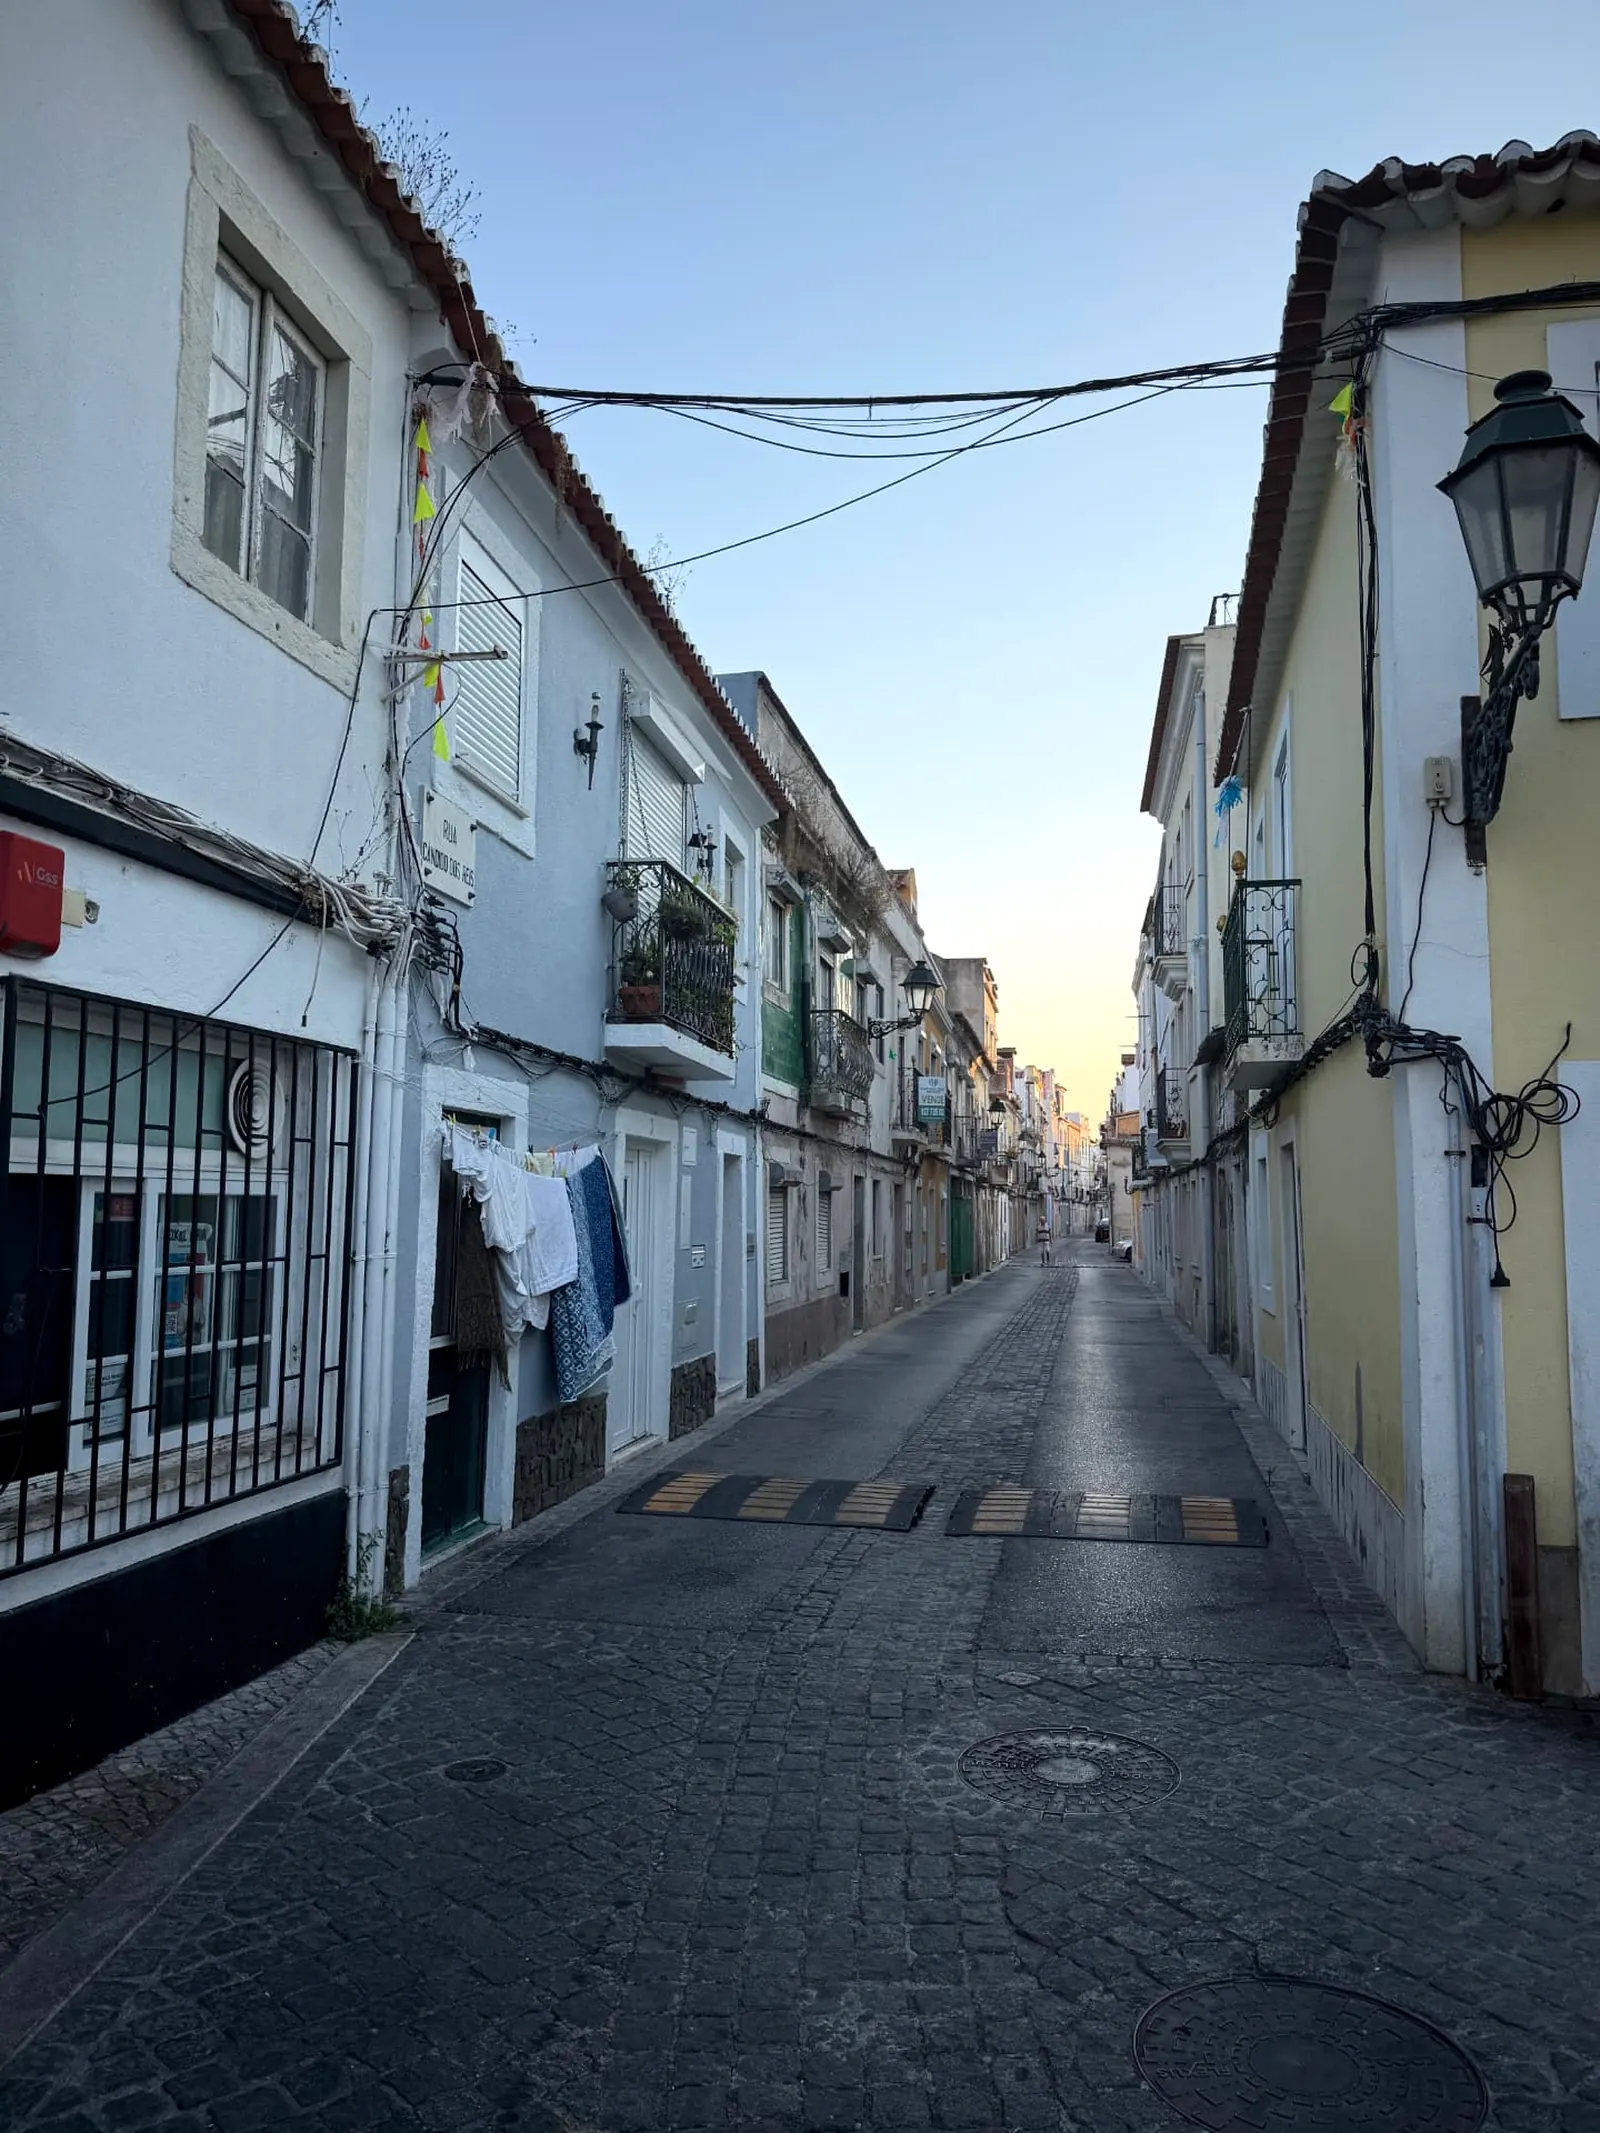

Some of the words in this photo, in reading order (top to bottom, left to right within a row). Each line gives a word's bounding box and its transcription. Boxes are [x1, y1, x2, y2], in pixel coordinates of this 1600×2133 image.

[443, 819, 457, 845] RUA
[449, 857, 461, 880] DOS
[461, 864, 474, 888] REIS
